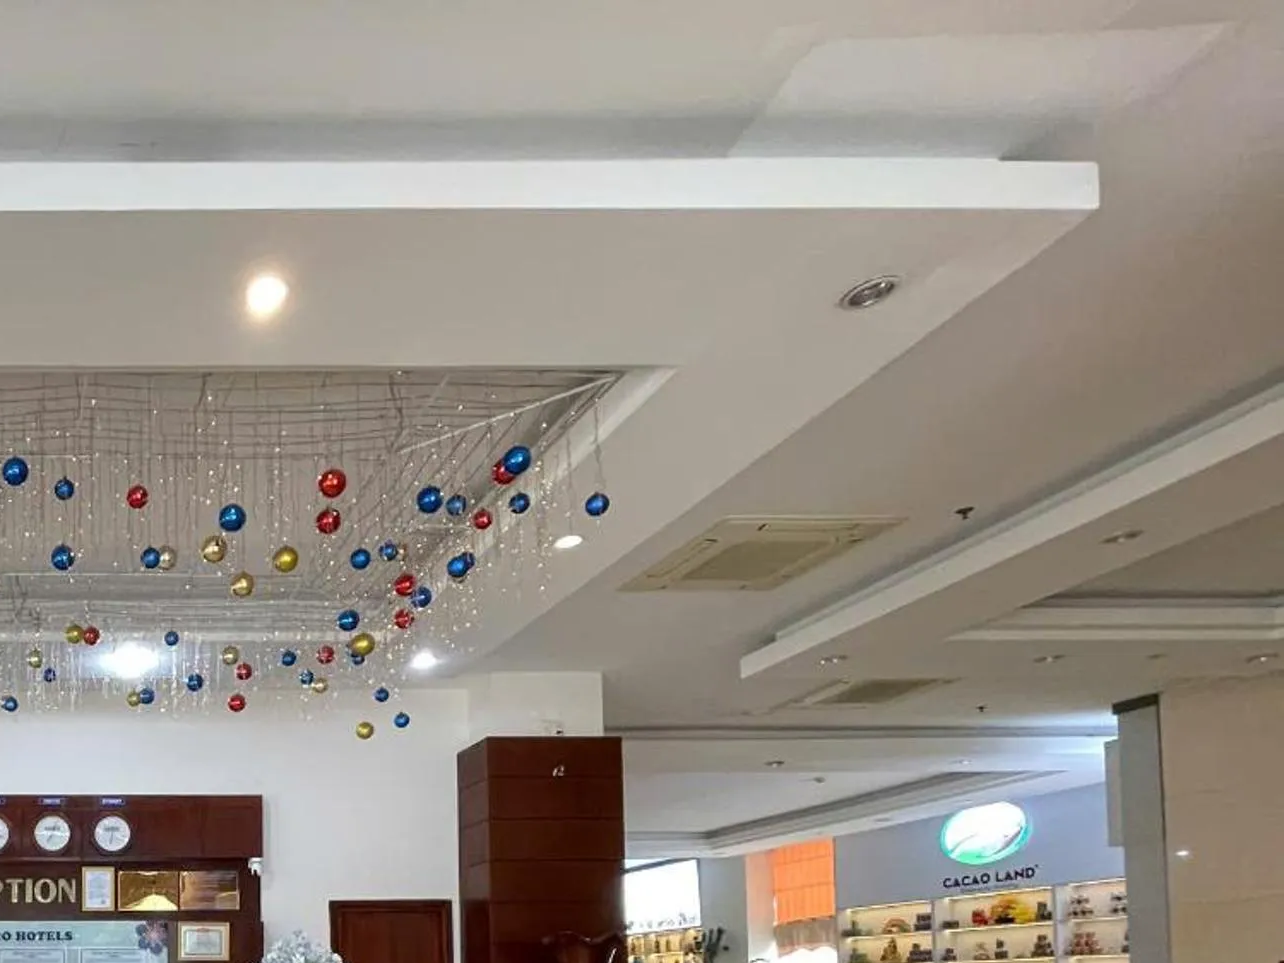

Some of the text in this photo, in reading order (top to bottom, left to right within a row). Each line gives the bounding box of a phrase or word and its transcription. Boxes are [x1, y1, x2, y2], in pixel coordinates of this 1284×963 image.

[942, 872, 991, 889] CACAO
[995, 867, 1036, 883] LAND
[15, 931, 73, 942] HOTELS
